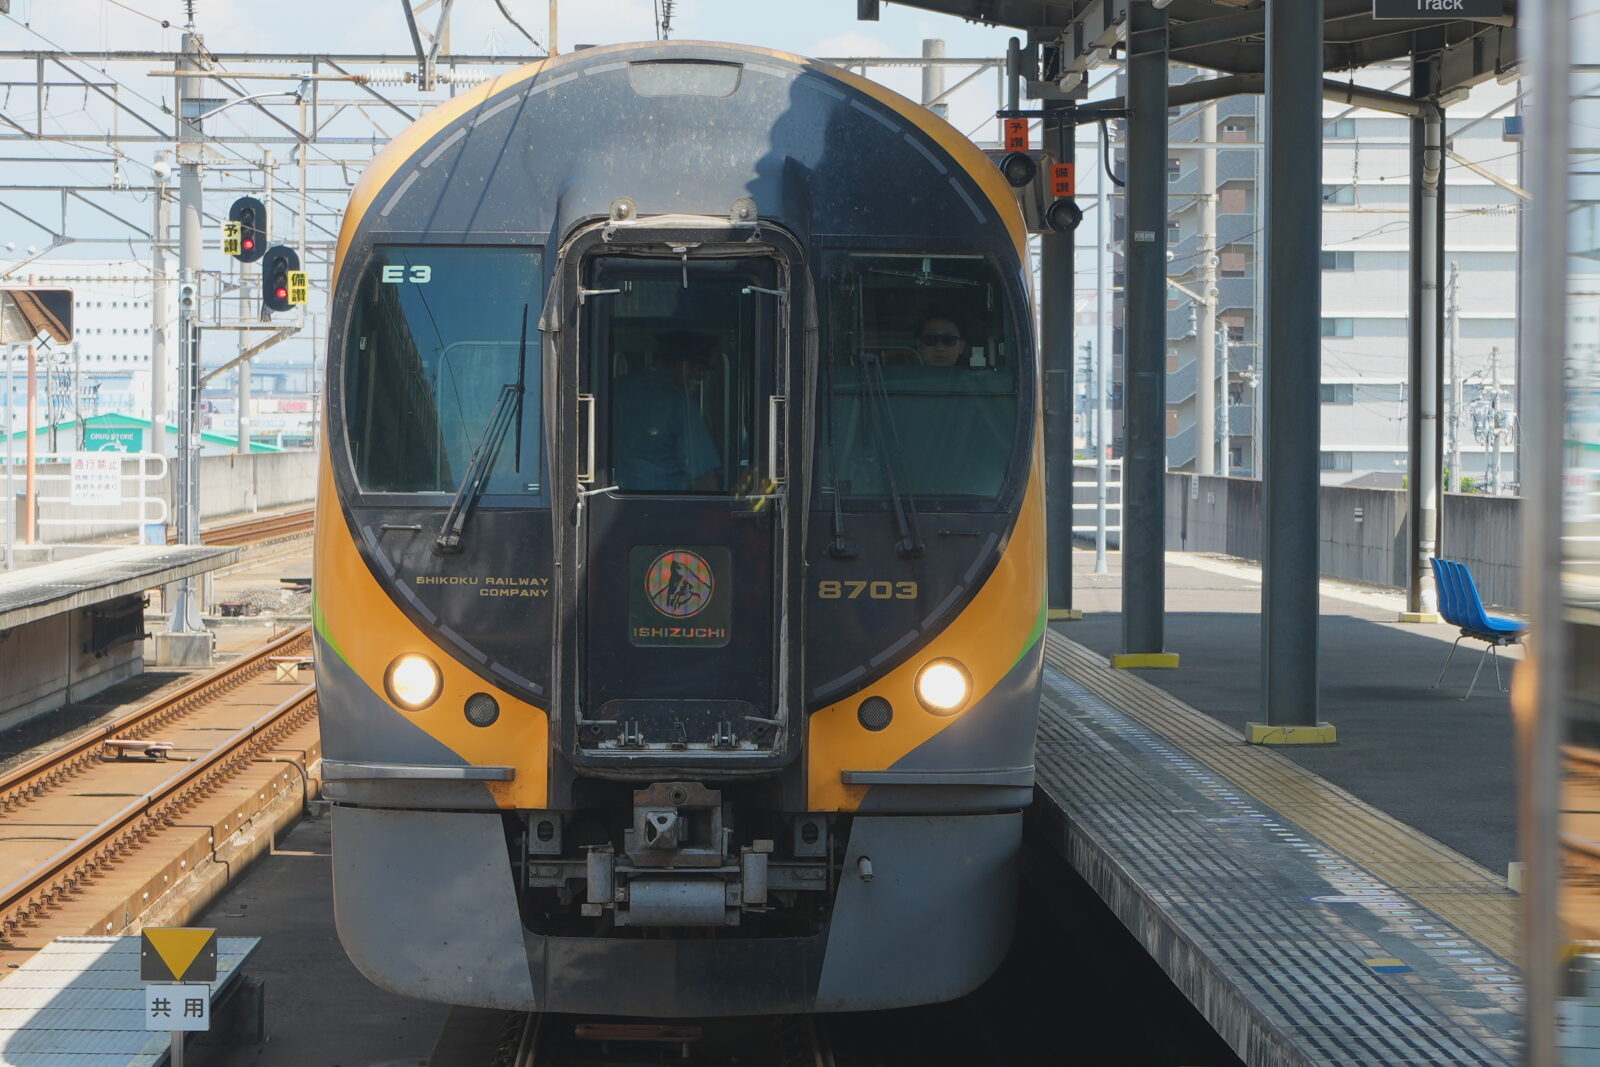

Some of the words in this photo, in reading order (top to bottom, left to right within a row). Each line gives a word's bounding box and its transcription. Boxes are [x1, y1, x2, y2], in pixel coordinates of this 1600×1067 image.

[1416, 0, 1463, 10] Track
[382, 265, 432, 284] E3
[75, 459, 118, 470] 通行禁止
[415, 576, 479, 585] SHIKOKU
[485, 577, 549, 586] RAILWAY
[479, 588, 549, 597] COMPANY
[818, 580, 918, 600] 8703
[633, 627, 725, 638] ISHIZUCHI
[151, 997, 204, 1018] 共用
